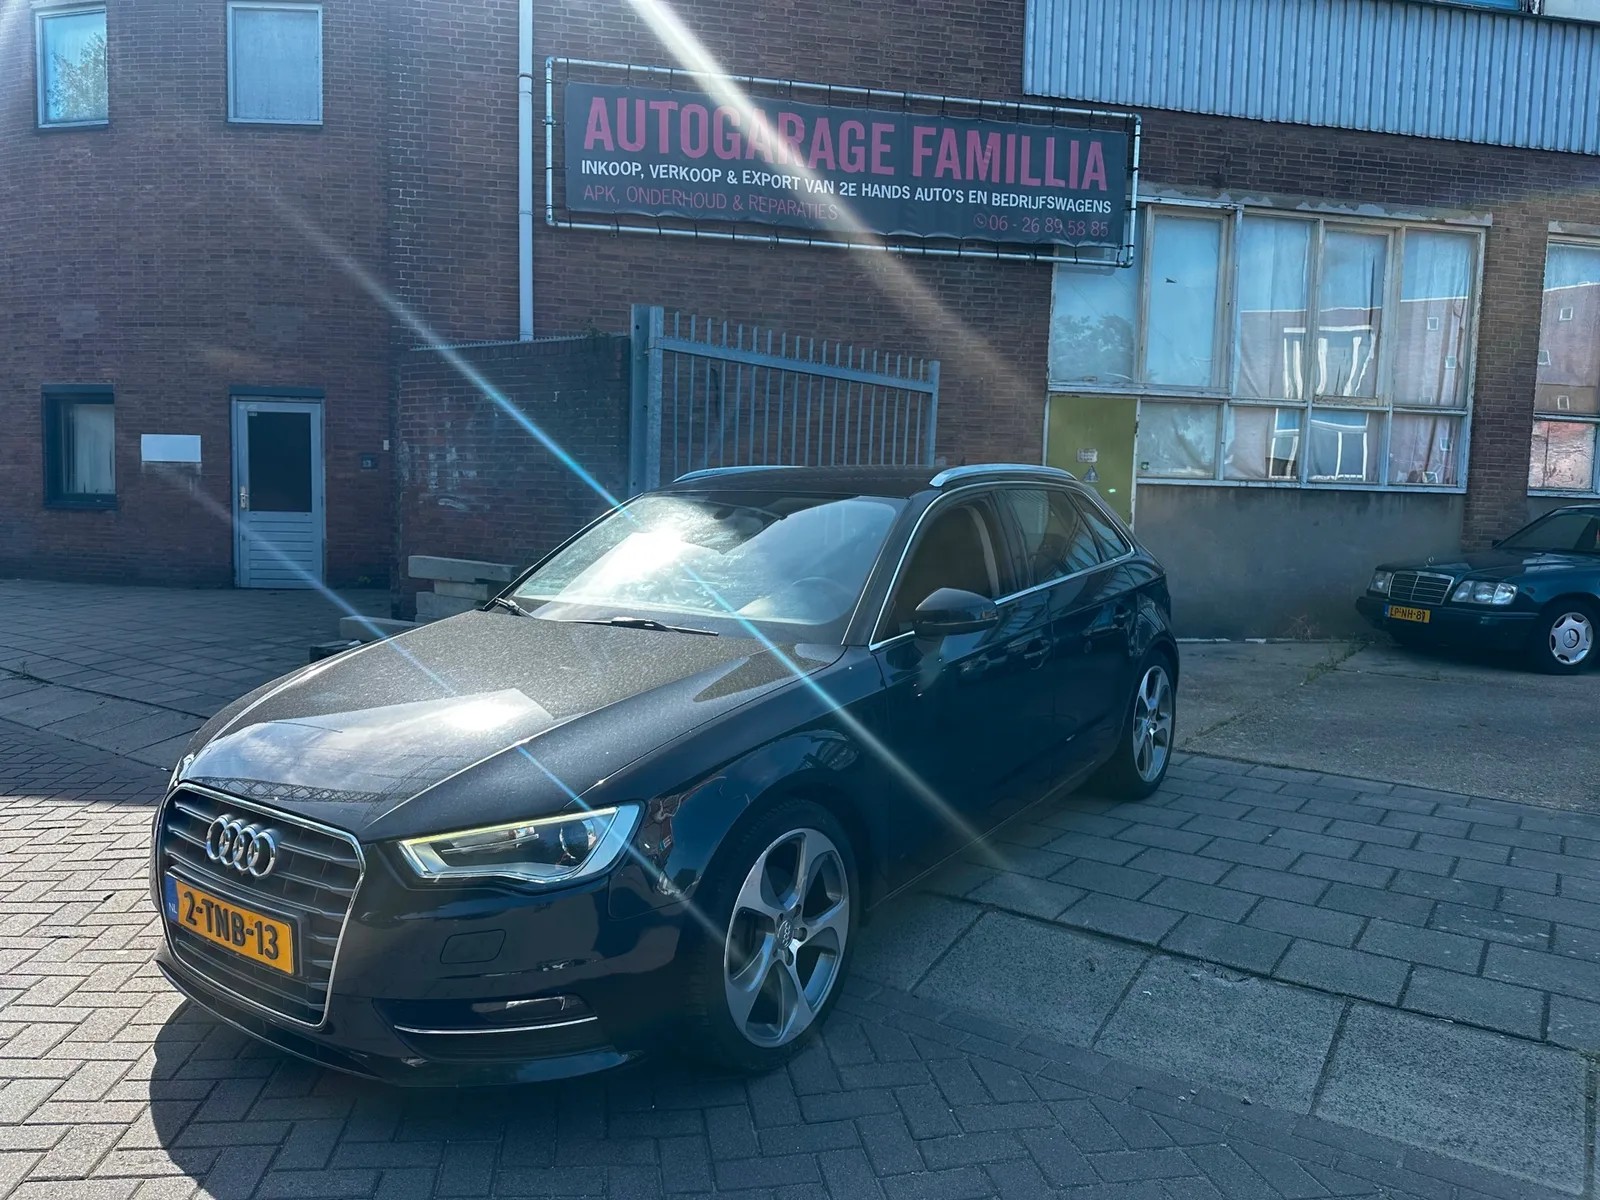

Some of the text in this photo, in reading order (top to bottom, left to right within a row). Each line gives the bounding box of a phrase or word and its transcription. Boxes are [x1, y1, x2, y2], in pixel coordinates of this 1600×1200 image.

[583, 96, 1108, 191] AUTOGARAGE FAMILLIA
[581, 160, 1112, 214] INKOOP, VERKOOP & EXPORT VAN 2E HANDS AUTO'S EN BEDRIJFSWAGENS
[583, 184, 838, 220] APK, ONDERHOUD & REPARATIES
[989, 214, 1008, 231] 06
[1021, 216, 1040, 233] 26
[1044, 217, 1063, 234] 89
[1067, 220, 1086, 236] 58
[1090, 220, 1109, 237] 85
[168, 902, 178, 914] NL
[184, 891, 279, 960] 2-TNB-13
